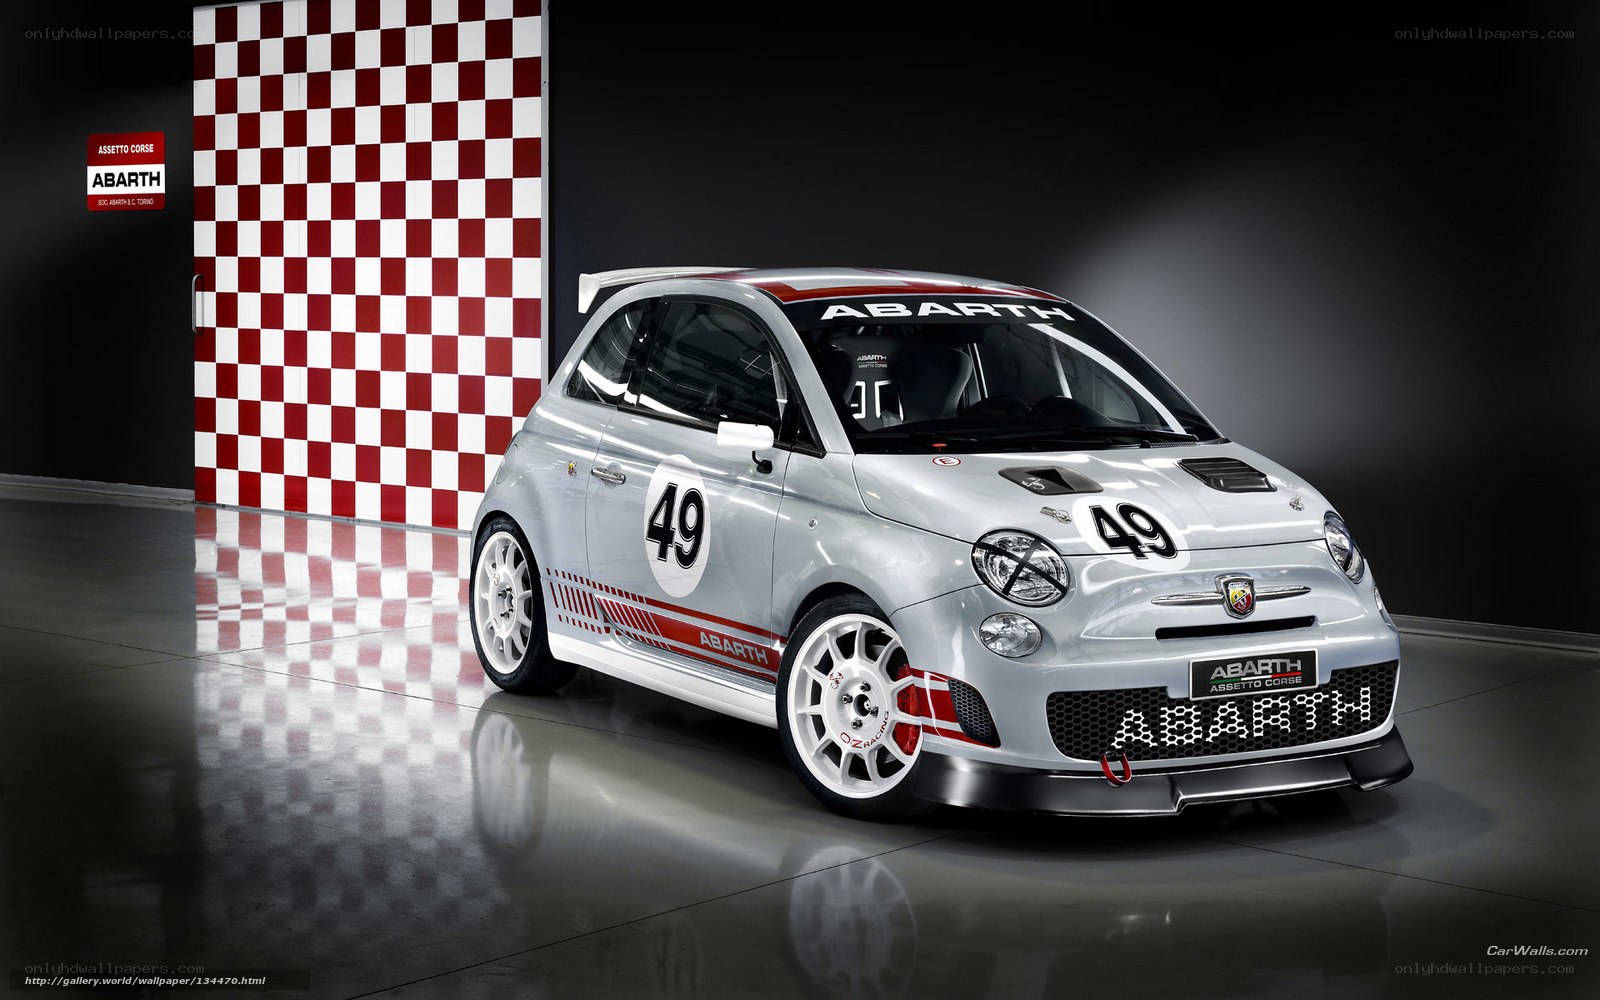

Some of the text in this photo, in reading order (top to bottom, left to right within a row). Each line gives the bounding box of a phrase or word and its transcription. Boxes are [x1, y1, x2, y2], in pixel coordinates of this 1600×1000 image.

[98, 144, 154, 154] ASSETTO CORSE
[92, 171, 160, 188] ABARTH
[820, 302, 1076, 321] ABARTH
[646, 482, 705, 569] 49
[1089, 502, 1178, 560] 49
[700, 631, 769, 664] ABARTH
[1210, 659, 1302, 680] ABARTH
[1210, 676, 1302, 692] ASSETTO CORSE
[863, 711, 889, 748] RACING
[1110, 686, 1371, 749] ABARTH
